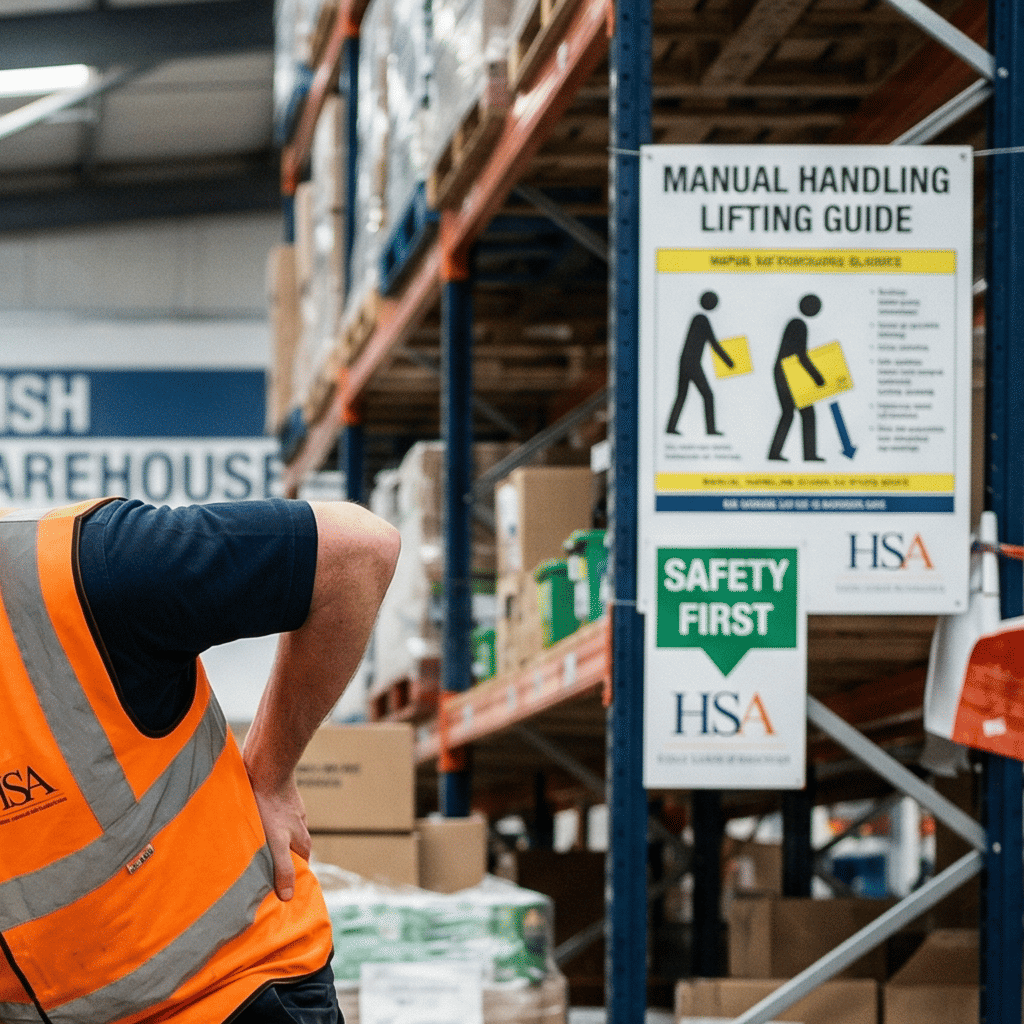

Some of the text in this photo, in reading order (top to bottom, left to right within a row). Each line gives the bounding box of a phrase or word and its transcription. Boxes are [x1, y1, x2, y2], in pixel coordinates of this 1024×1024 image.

[663, 165, 950, 193] MANUAL HANDLING
[701, 205, 913, 233] LIFTING GUIDE
[847, 531, 934, 571] HSA
[663, 557, 790, 592] SAFETY
[678, 602, 774, 637] FIRST
[672, 690, 775, 737] HSA
